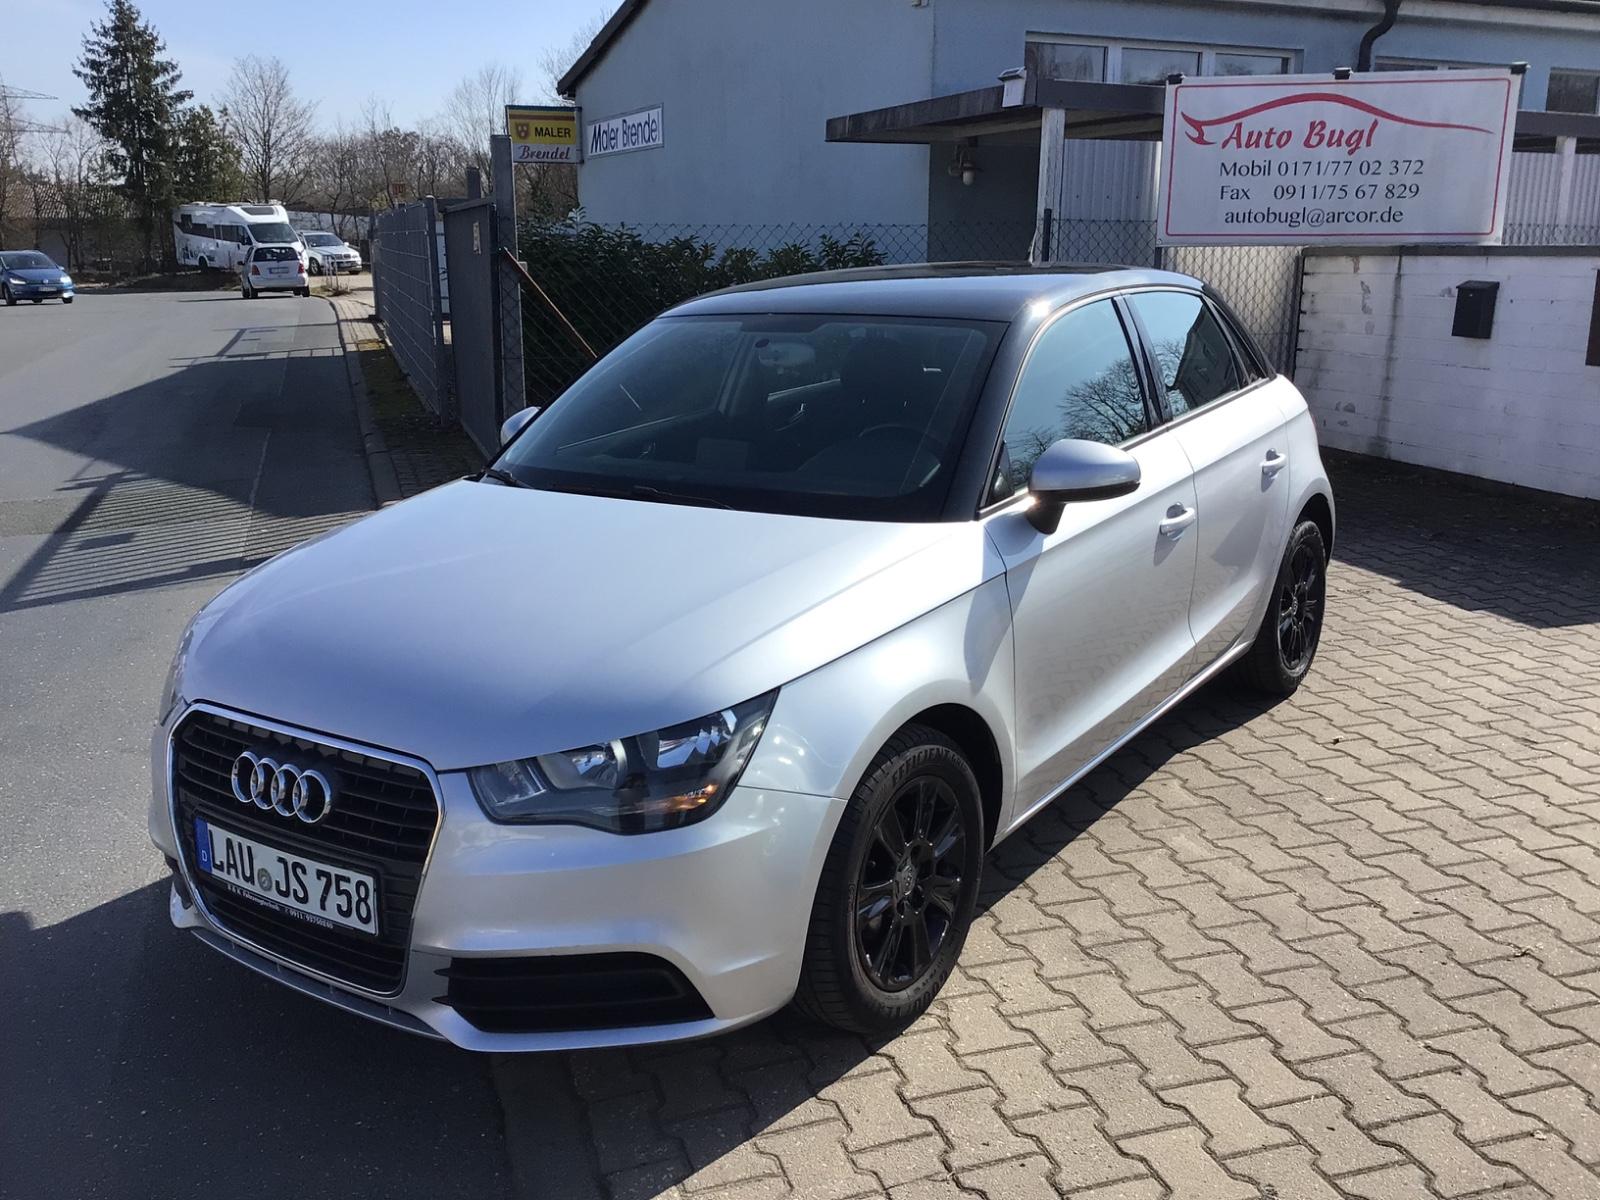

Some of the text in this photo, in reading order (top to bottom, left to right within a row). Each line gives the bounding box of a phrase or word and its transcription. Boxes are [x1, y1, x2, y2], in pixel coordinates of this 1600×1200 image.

[534, 127, 572, 139] MALER
[590, 112, 660, 154] Maler Brendel
[1221, 118, 1379, 155] Auto Bugl
[520, 145, 570, 160] Brendel
[1219, 159, 1424, 178] Mobil 0171/77 02 372
[1220, 183, 1420, 201] Fax 0911/75 67 829
[1224, 206, 1404, 228] autobugl@arcor.de
[201, 849, 208, 862] D
[209, 830, 254, 886] LAU
[274, 856, 310, 905] JS
[316, 869, 371, 925] 758
